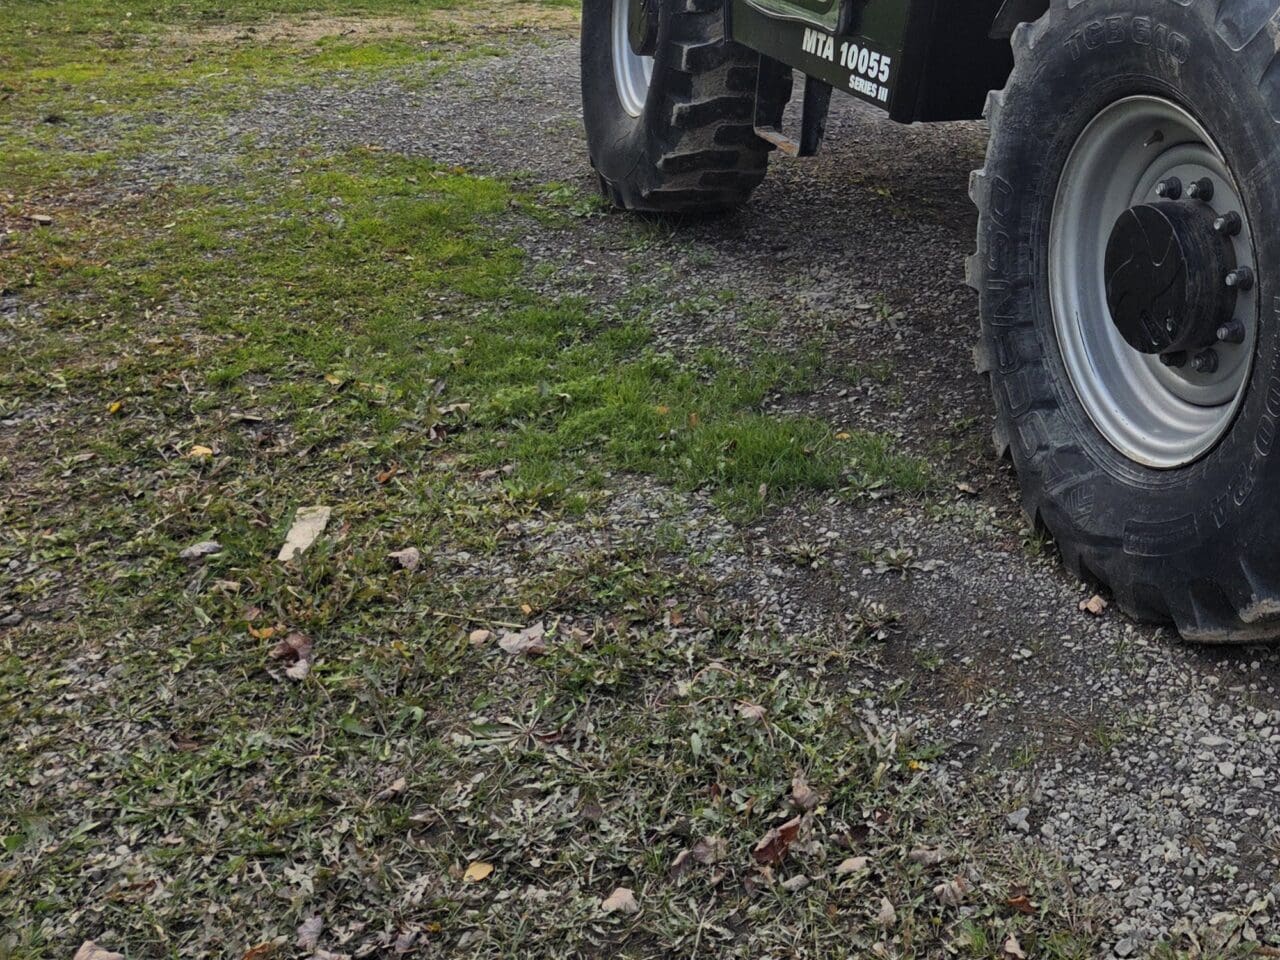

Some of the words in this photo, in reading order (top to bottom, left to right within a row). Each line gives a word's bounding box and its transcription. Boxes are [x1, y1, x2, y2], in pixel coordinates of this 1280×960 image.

[802, 27, 834, 62] MTA
[840, 41, 891, 83] 10055
[849, 74, 877, 98] SERIES
[877, 85, 889, 103] III
